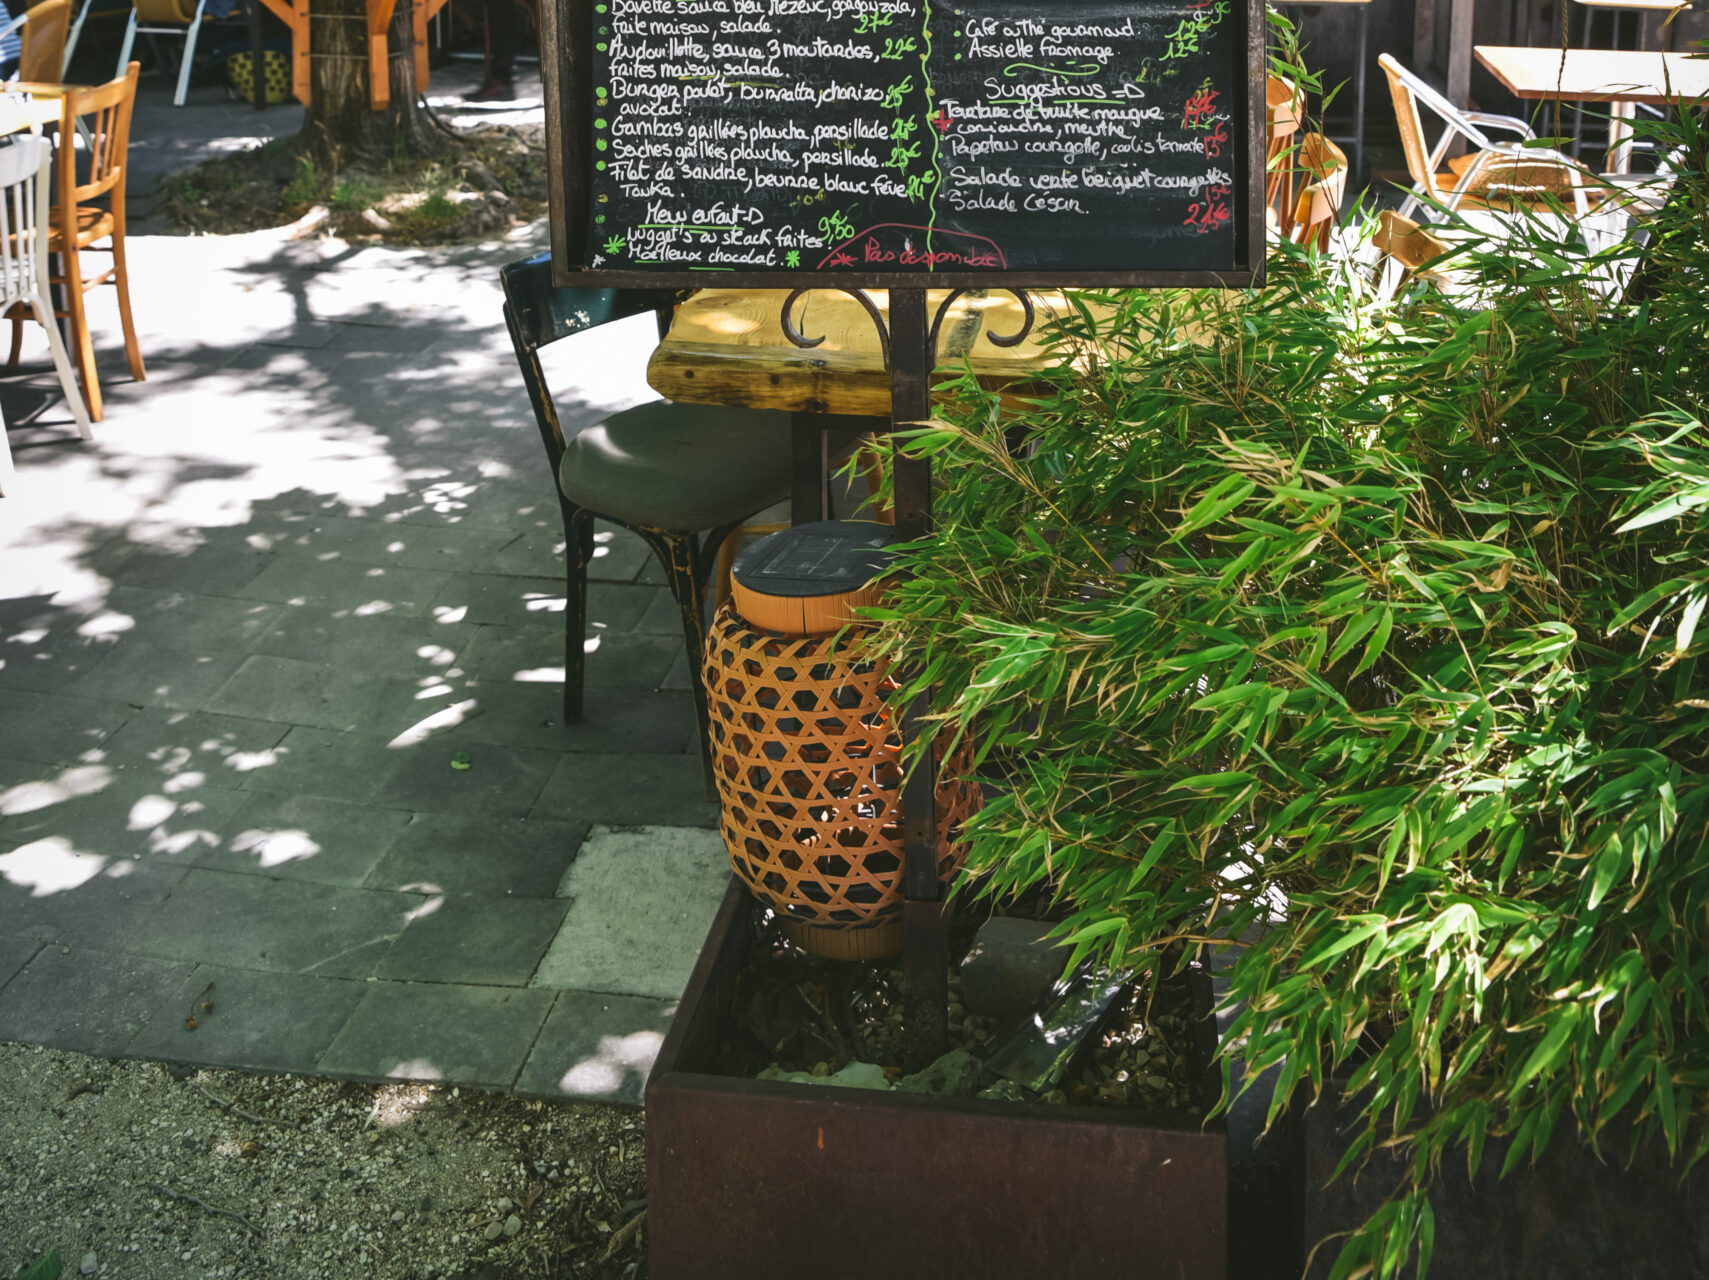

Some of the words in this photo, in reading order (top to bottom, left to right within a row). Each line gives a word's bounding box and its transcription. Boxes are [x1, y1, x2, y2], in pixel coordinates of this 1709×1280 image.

[677, 0, 730, 14] sauce
[965, 17, 999, 38] Café
[713, 43, 765, 59] sauce
[767, 39, 781, 60] 3
[968, 37, 1033, 59] Assiette
[608, 57, 657, 78] frites
[610, 76, 680, 106] Burger
[684, 77, 732, 107] poulet,
[939, 99, 1012, 120] Tartare
[611, 115, 684, 137] Gambas
[612, 139, 672, 159] Seiches
[608, 159, 650, 181] Filet
[654, 161, 676, 181] de
[755, 167, 821, 190] beurre
[824, 172, 870, 195] blanc
[950, 166, 1022, 187] Salade
[947, 189, 1018, 211] Salade
[700, 232, 717, 244] ou
[864, 235, 895, 263] Pas
